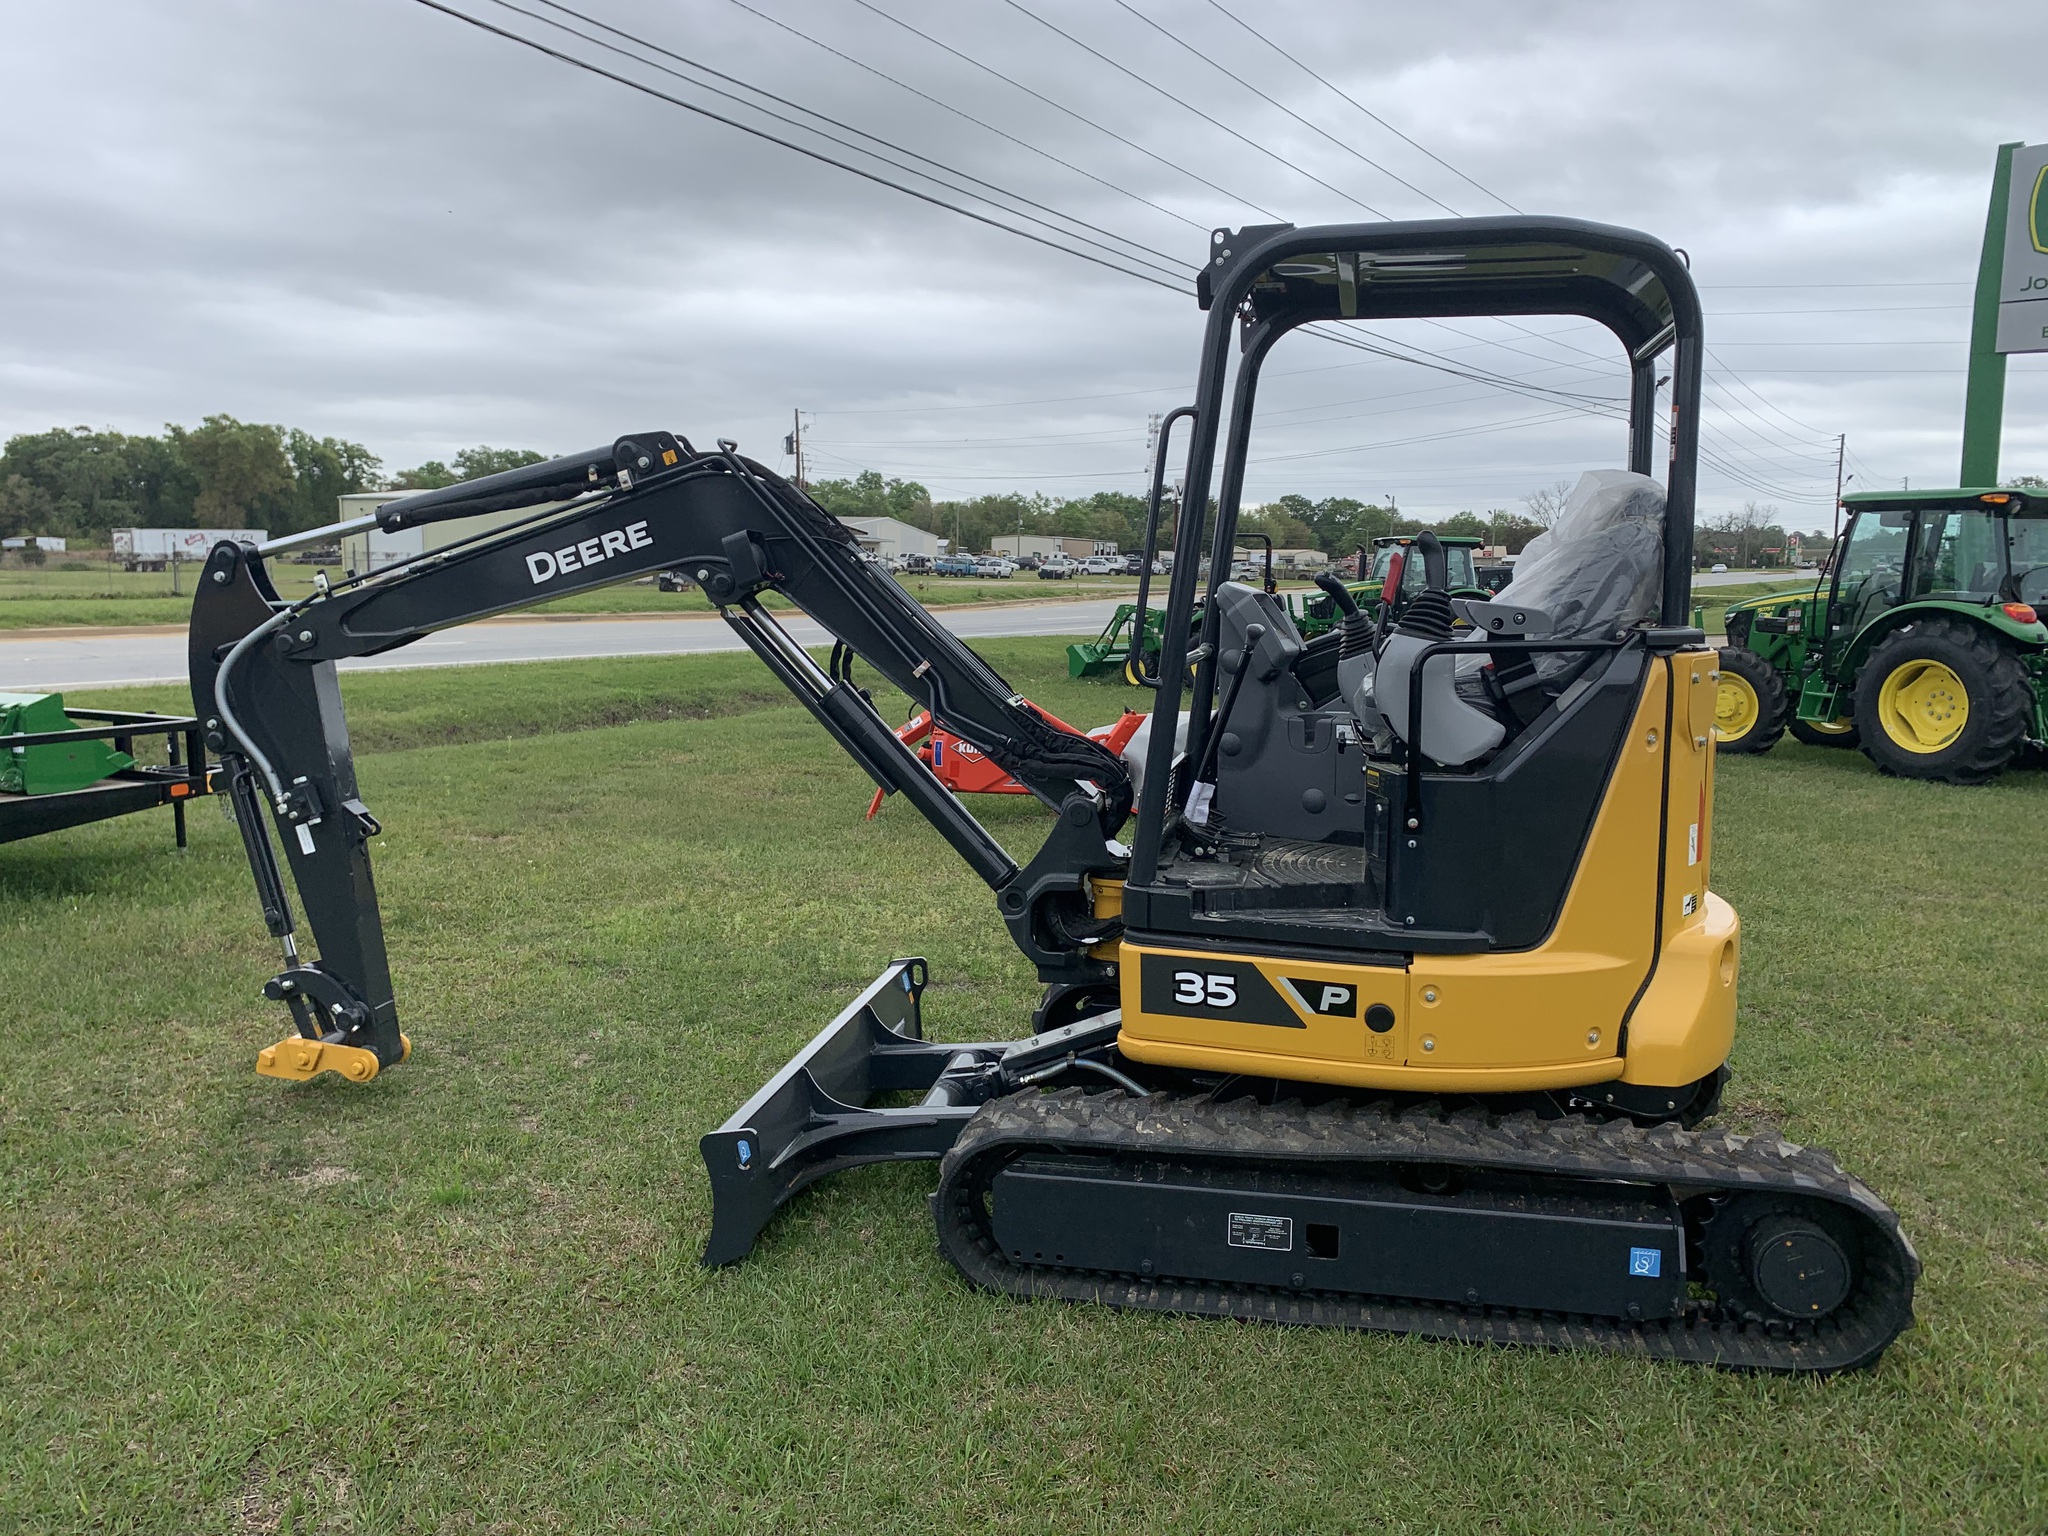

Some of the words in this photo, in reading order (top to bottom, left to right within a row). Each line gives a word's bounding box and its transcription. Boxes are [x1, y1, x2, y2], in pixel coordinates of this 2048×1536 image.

[525, 520, 653, 584] DEERE
[1174, 972, 1236, 1007] 35
[1319, 986, 1351, 1011] P
